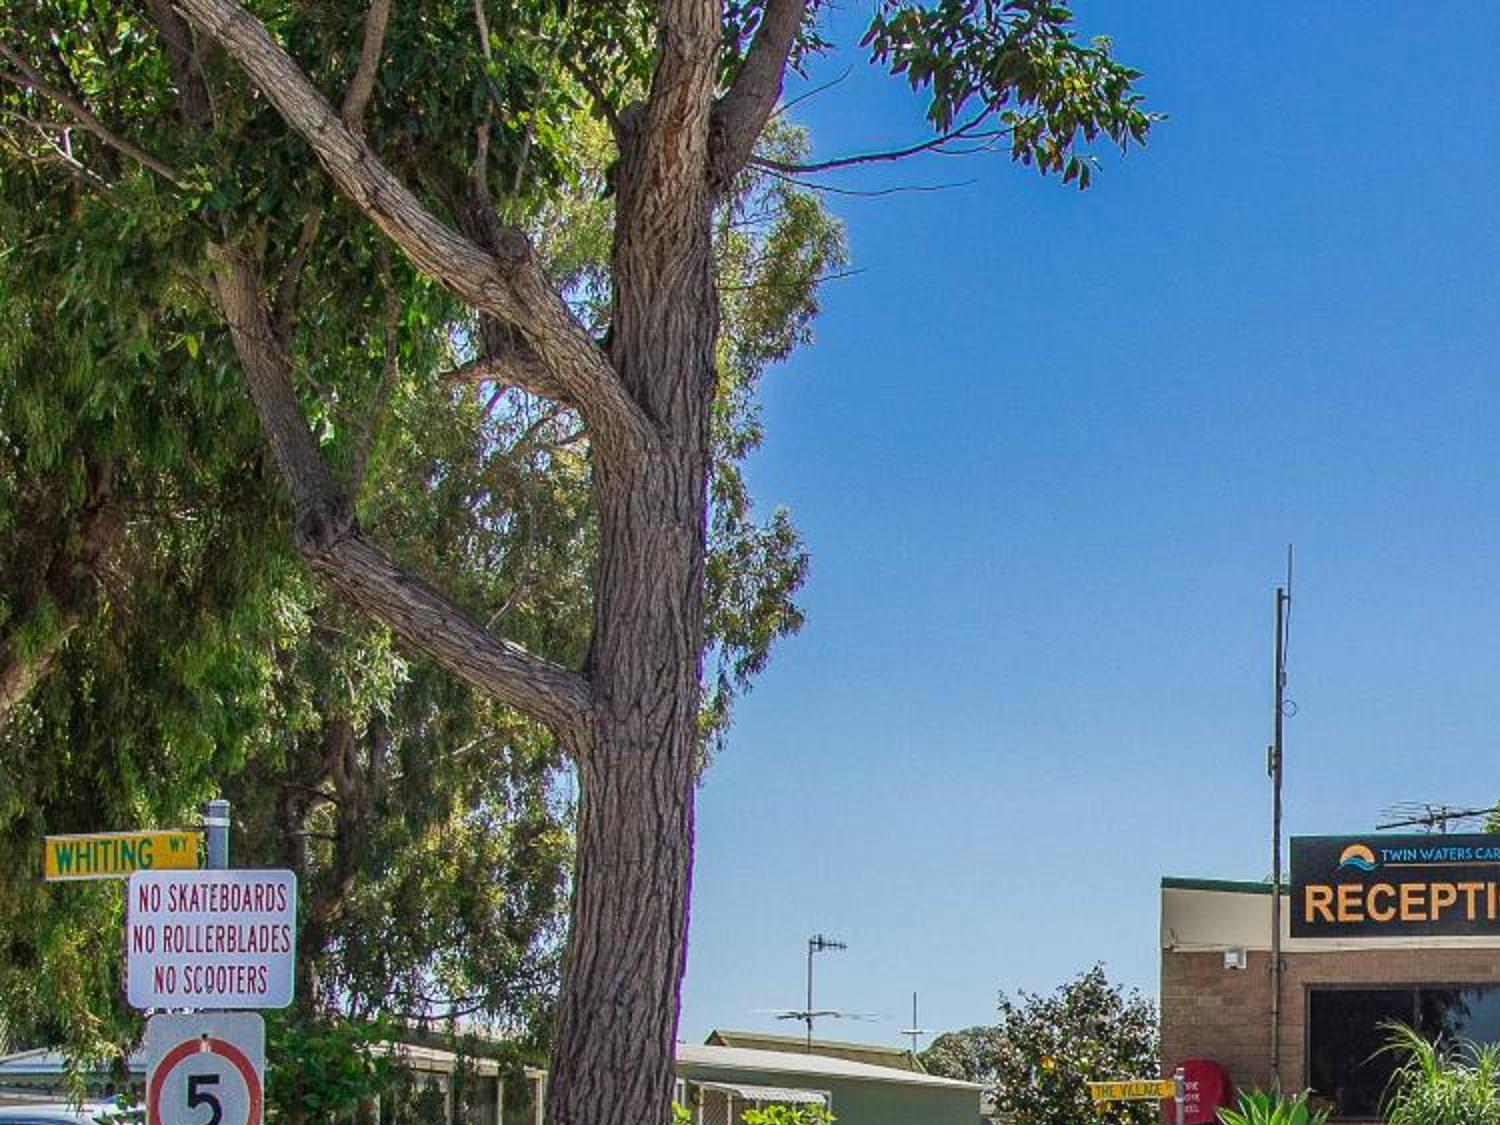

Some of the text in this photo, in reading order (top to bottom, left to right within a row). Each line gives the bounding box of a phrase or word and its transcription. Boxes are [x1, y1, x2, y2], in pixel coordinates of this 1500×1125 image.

[56, 835, 188, 872] WHITING WY
[1381, 849, 1417, 861] TWIN
[1420, 847, 1473, 860] WATERS
[139, 884, 287, 912] NO SKATEBOARDS
[133, 925, 291, 953] NO ROLLERBLADES
[154, 966, 267, 994] NO SCOOTERS
